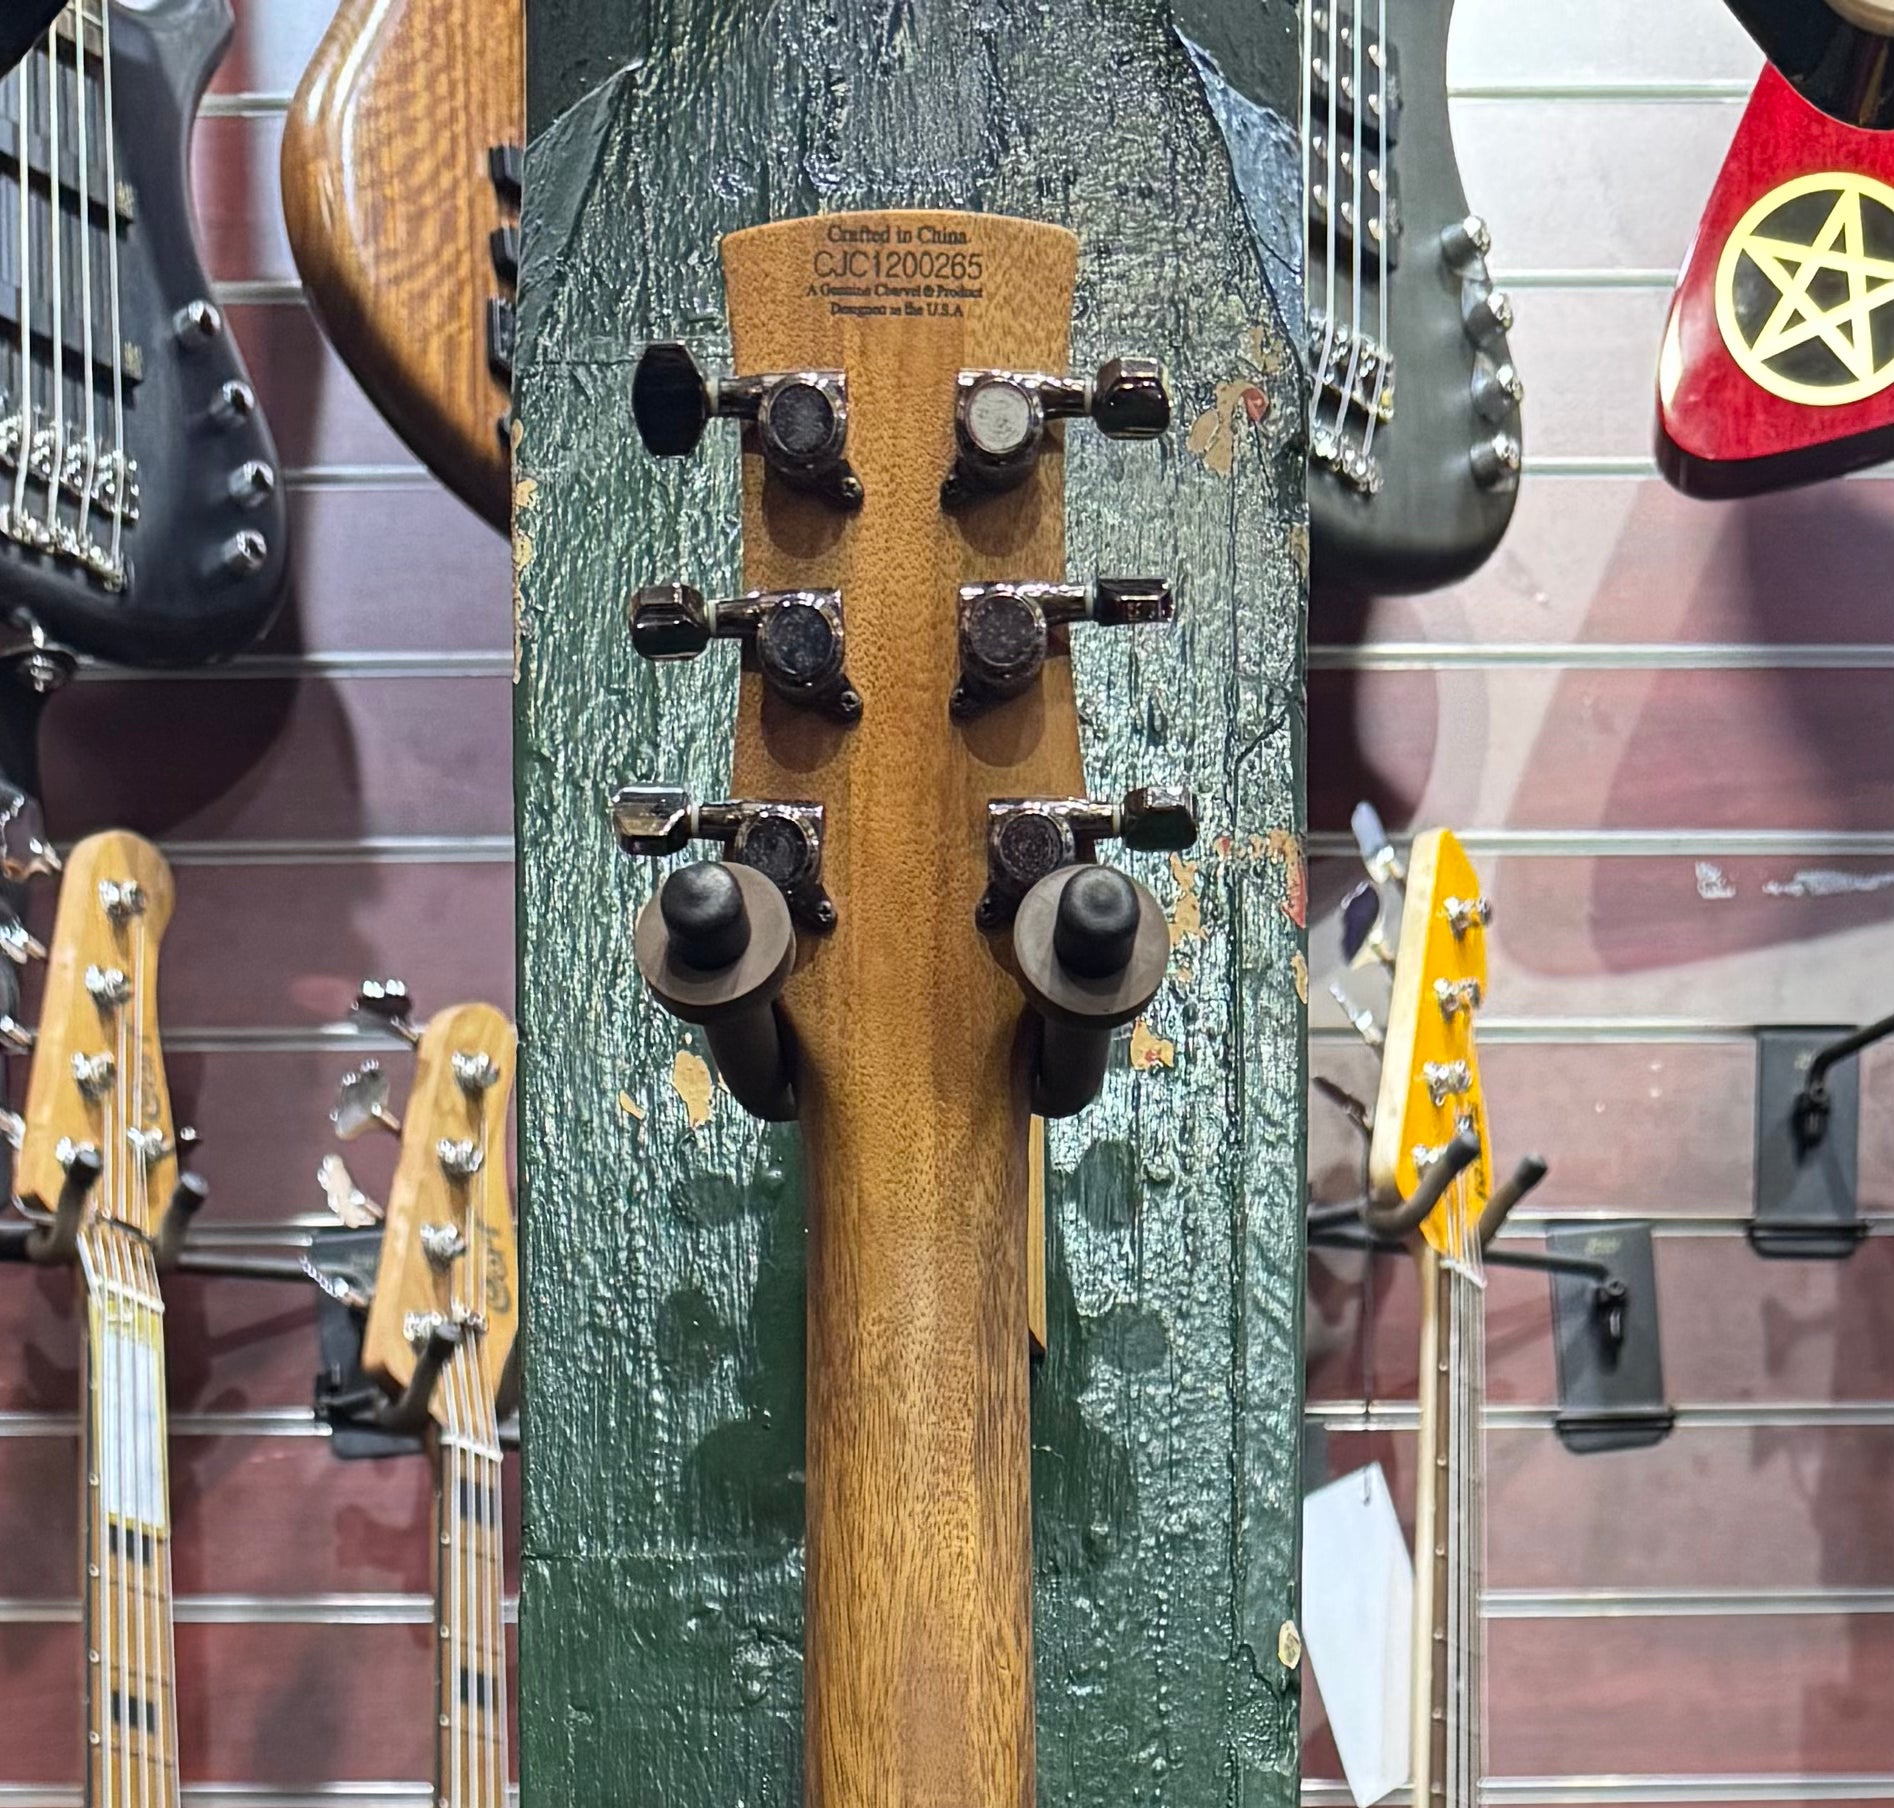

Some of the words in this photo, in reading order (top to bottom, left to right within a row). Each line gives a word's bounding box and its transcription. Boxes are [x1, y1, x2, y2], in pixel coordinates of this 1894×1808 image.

[828, 224, 890, 243] Crafted
[895, 224, 912, 244] in
[917, 224, 967, 245] China
[814, 250, 983, 279] CJC1200265
[806, 283, 818, 297] A
[820, 283, 871, 297] Genuine
[936, 284, 983, 298] Product
[831, 301, 887, 317] Designed
[904, 301, 923, 316] the
